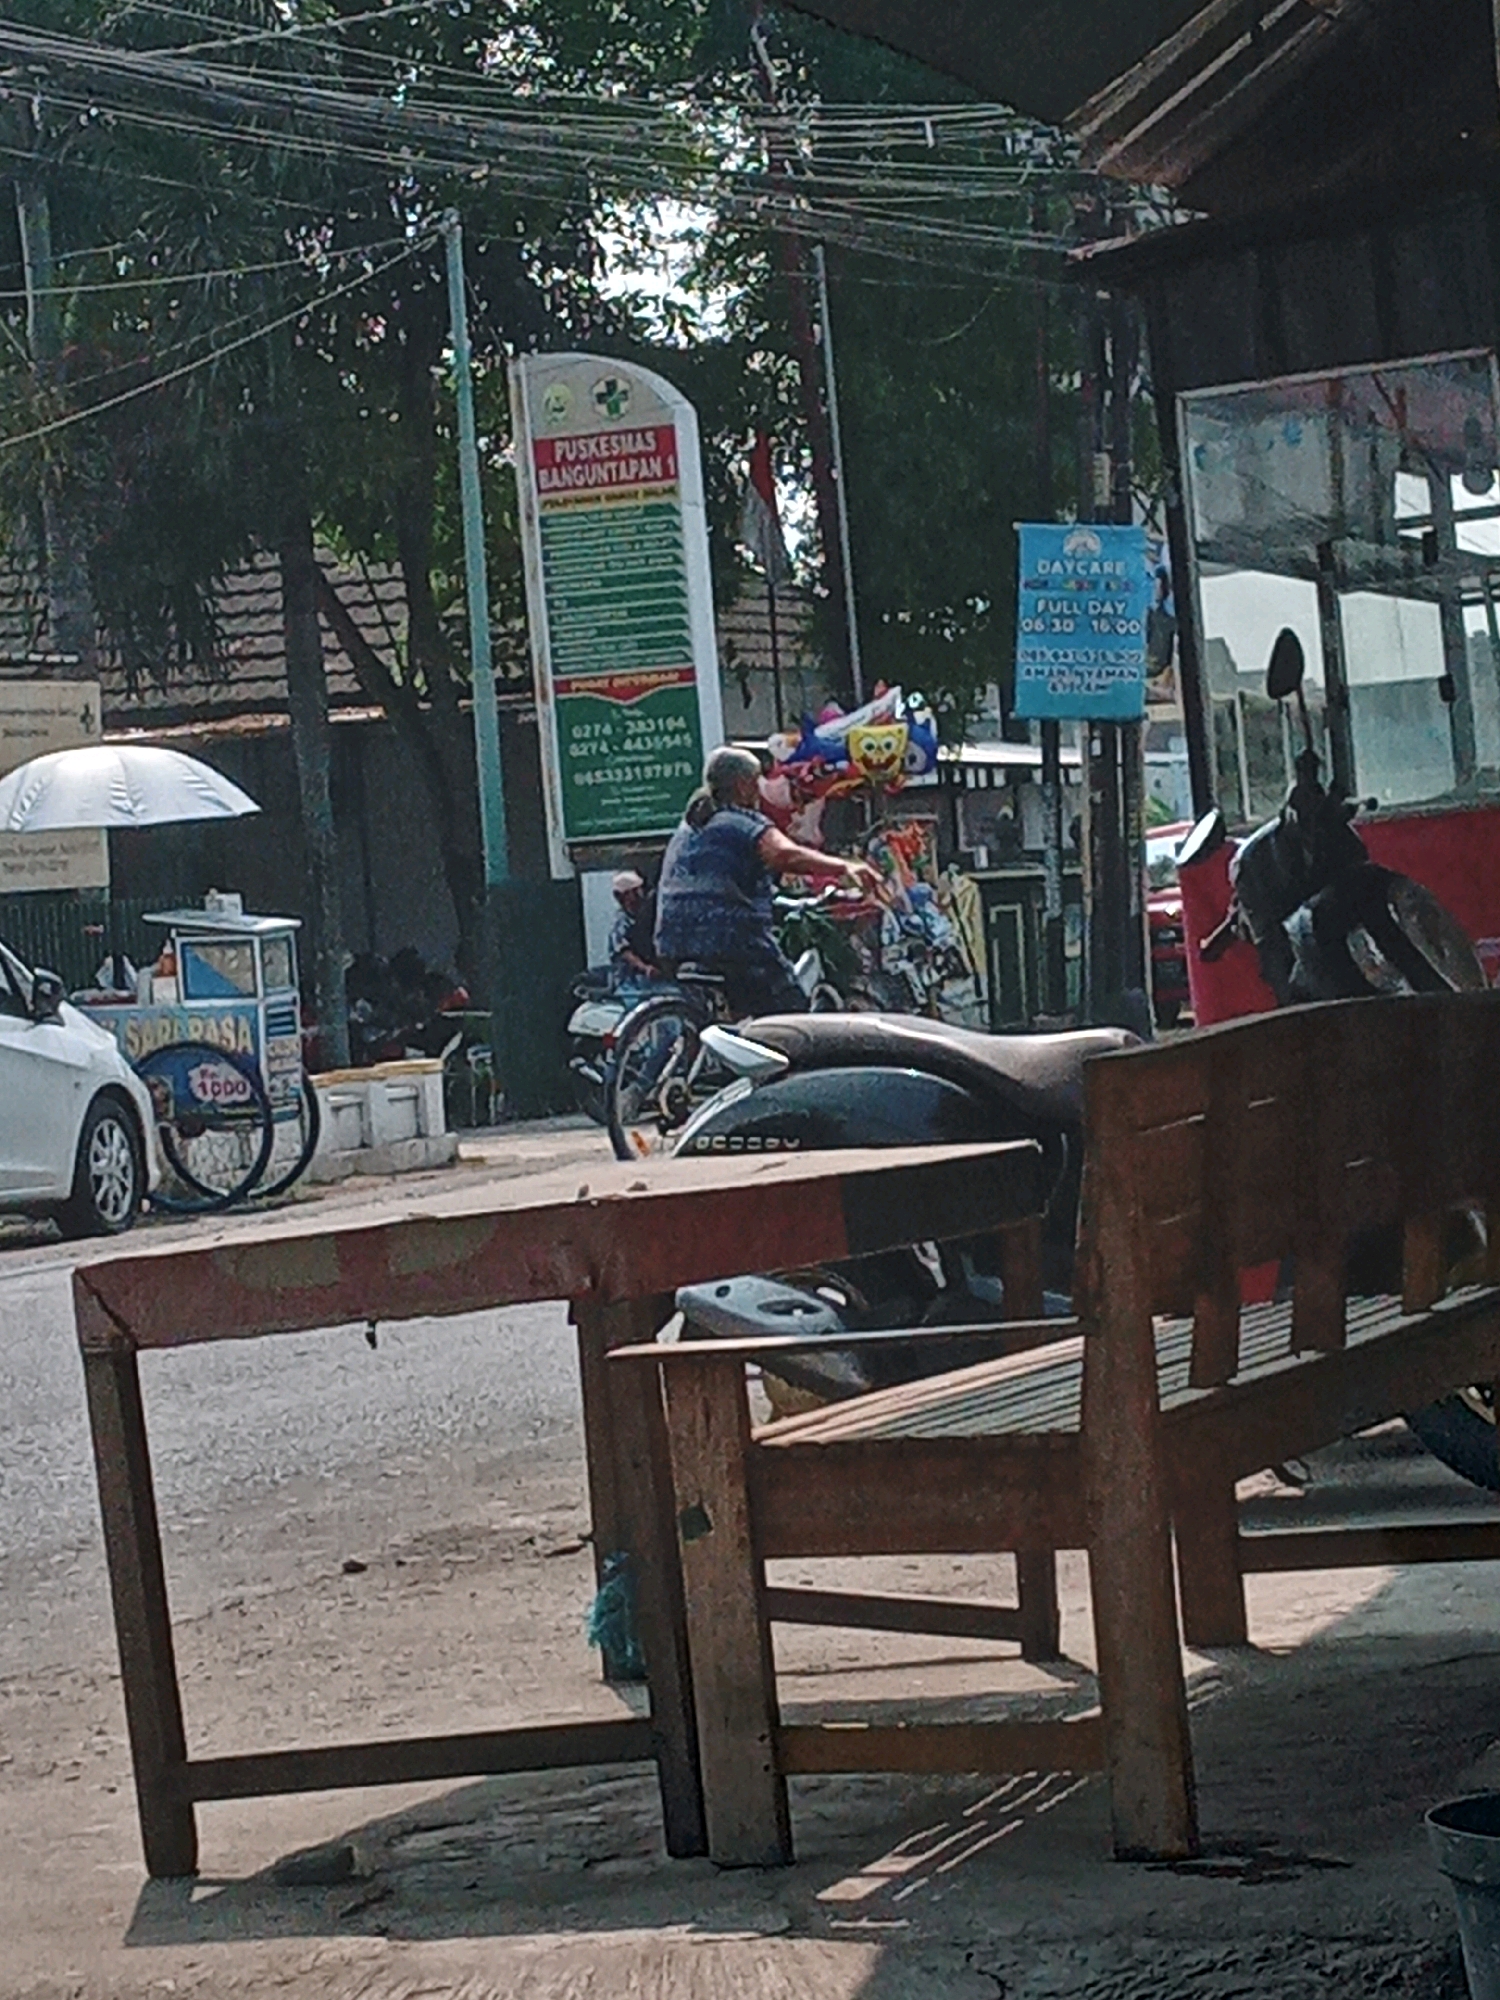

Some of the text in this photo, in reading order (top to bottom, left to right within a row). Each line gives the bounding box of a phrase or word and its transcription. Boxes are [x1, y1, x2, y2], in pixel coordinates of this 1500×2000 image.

[554, 431, 656, 463] PUSKESMAS
[538, 455, 676, 490] BANGUNTAPAN 1
[1037, 561, 1126, 575] DAYCARE
[1037, 599, 1126, 615] FULL DAY
[188, 1013, 253, 1057] RASA
[198, 1080, 247, 1097] 1000
